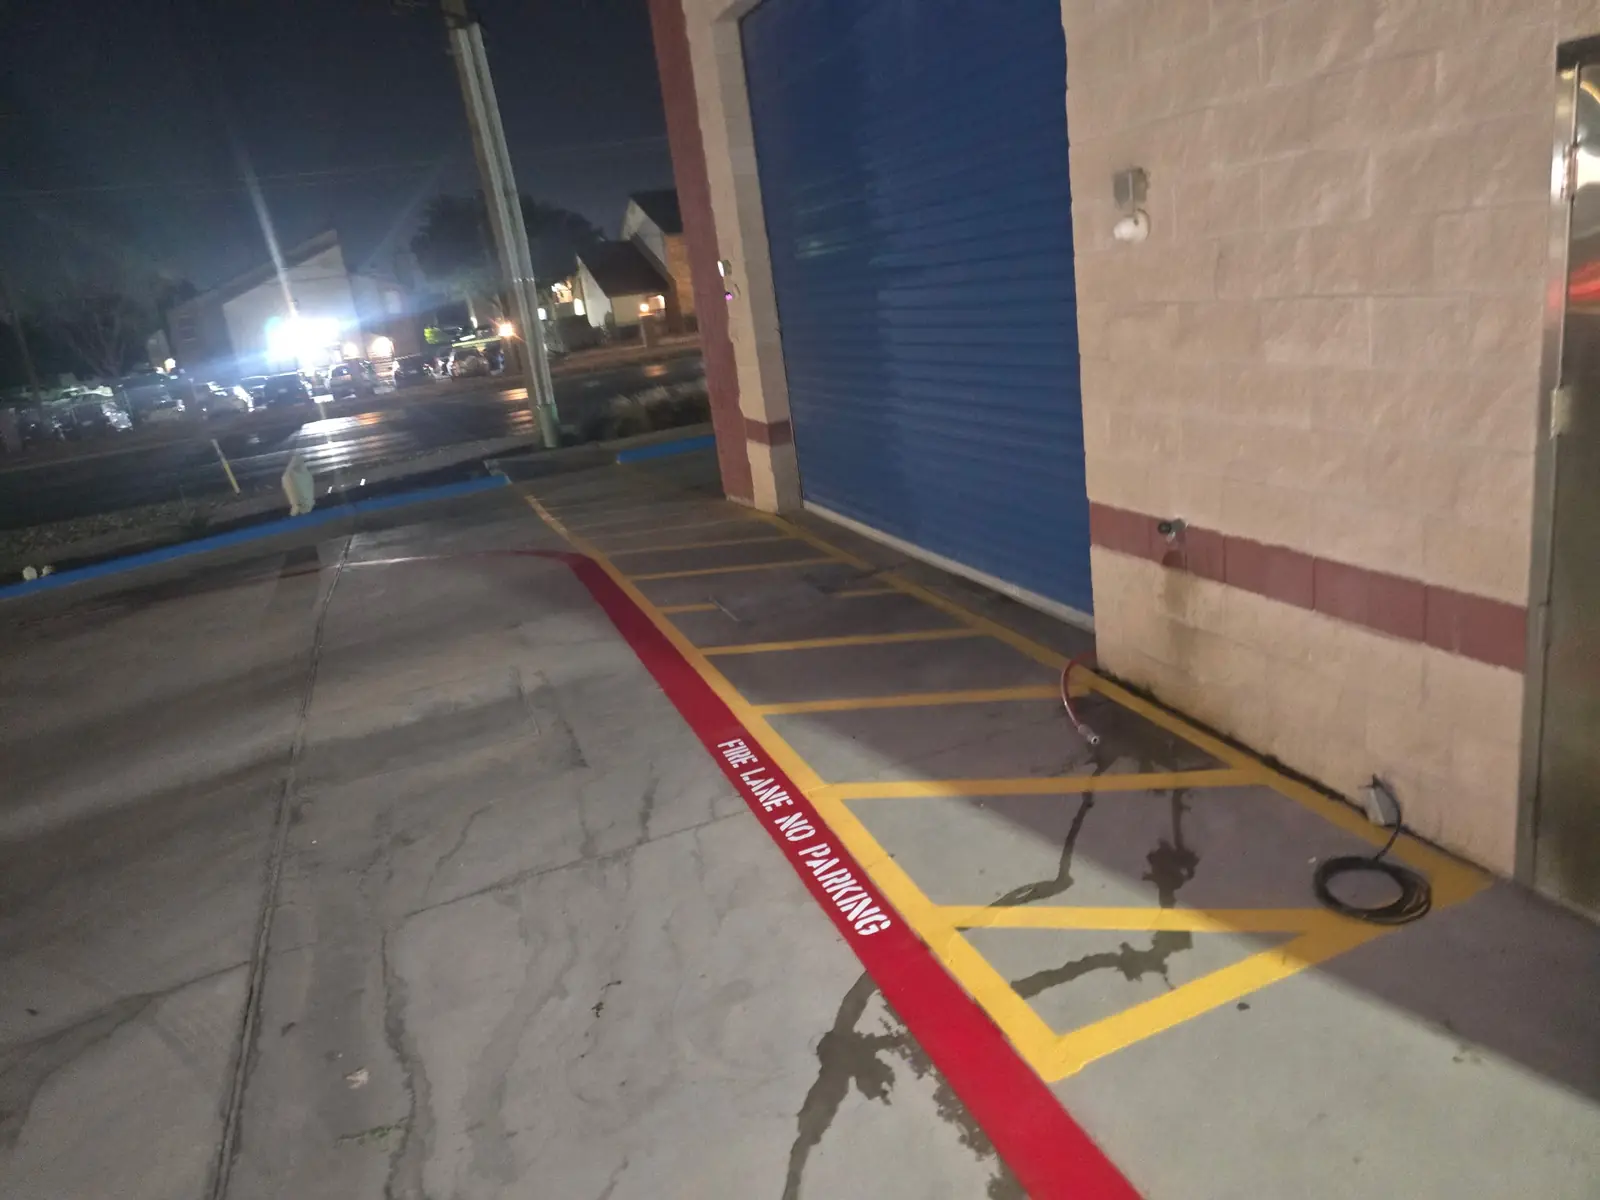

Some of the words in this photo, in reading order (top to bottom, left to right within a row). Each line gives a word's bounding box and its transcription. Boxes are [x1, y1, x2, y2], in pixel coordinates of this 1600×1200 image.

[717, 738, 758, 768] FIRE
[740, 767, 794, 812] LANE
[774, 812, 816, 841] NO
[798, 843, 891, 935] PARKING
